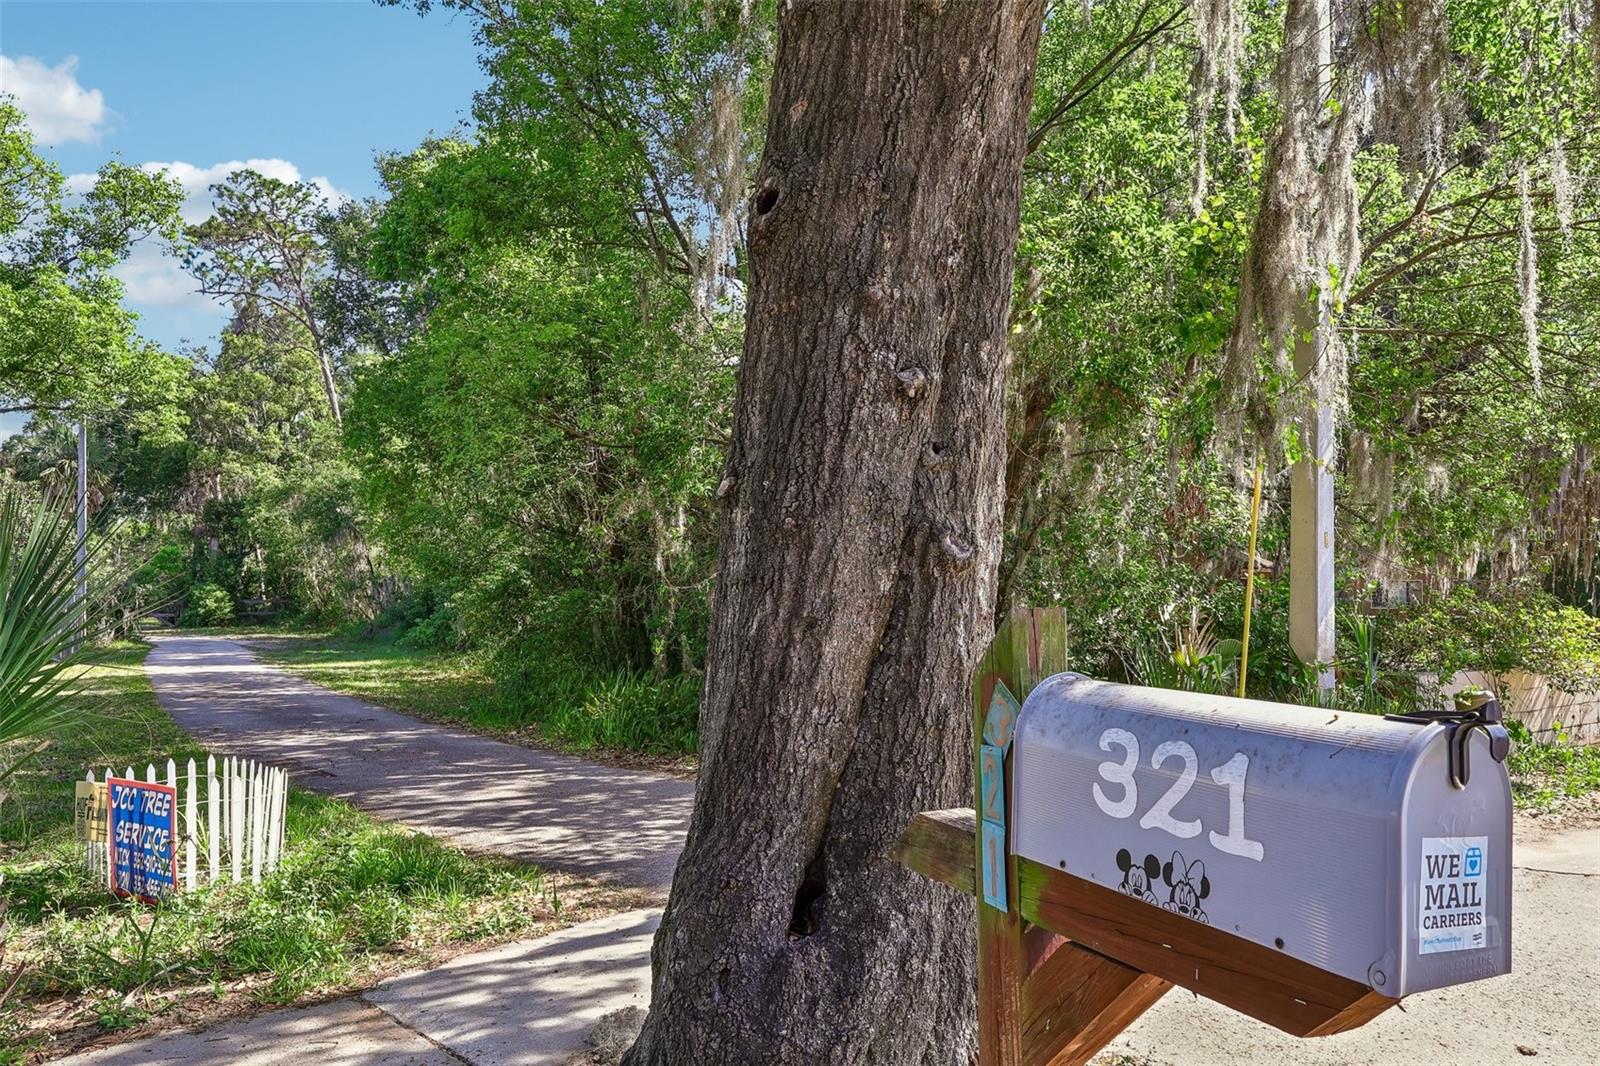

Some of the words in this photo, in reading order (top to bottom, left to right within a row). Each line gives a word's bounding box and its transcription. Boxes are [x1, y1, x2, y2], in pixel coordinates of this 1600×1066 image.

[112, 785, 137, 811] JCC
[140, 791, 172, 817] TREE
[1092, 727, 1264, 862] 321
[115, 820, 169, 852] SERVICE
[1425, 854, 1460, 879] WE
[1424, 882, 1482, 911] MAIL
[1423, 912, 1482, 930] CARRIERS
